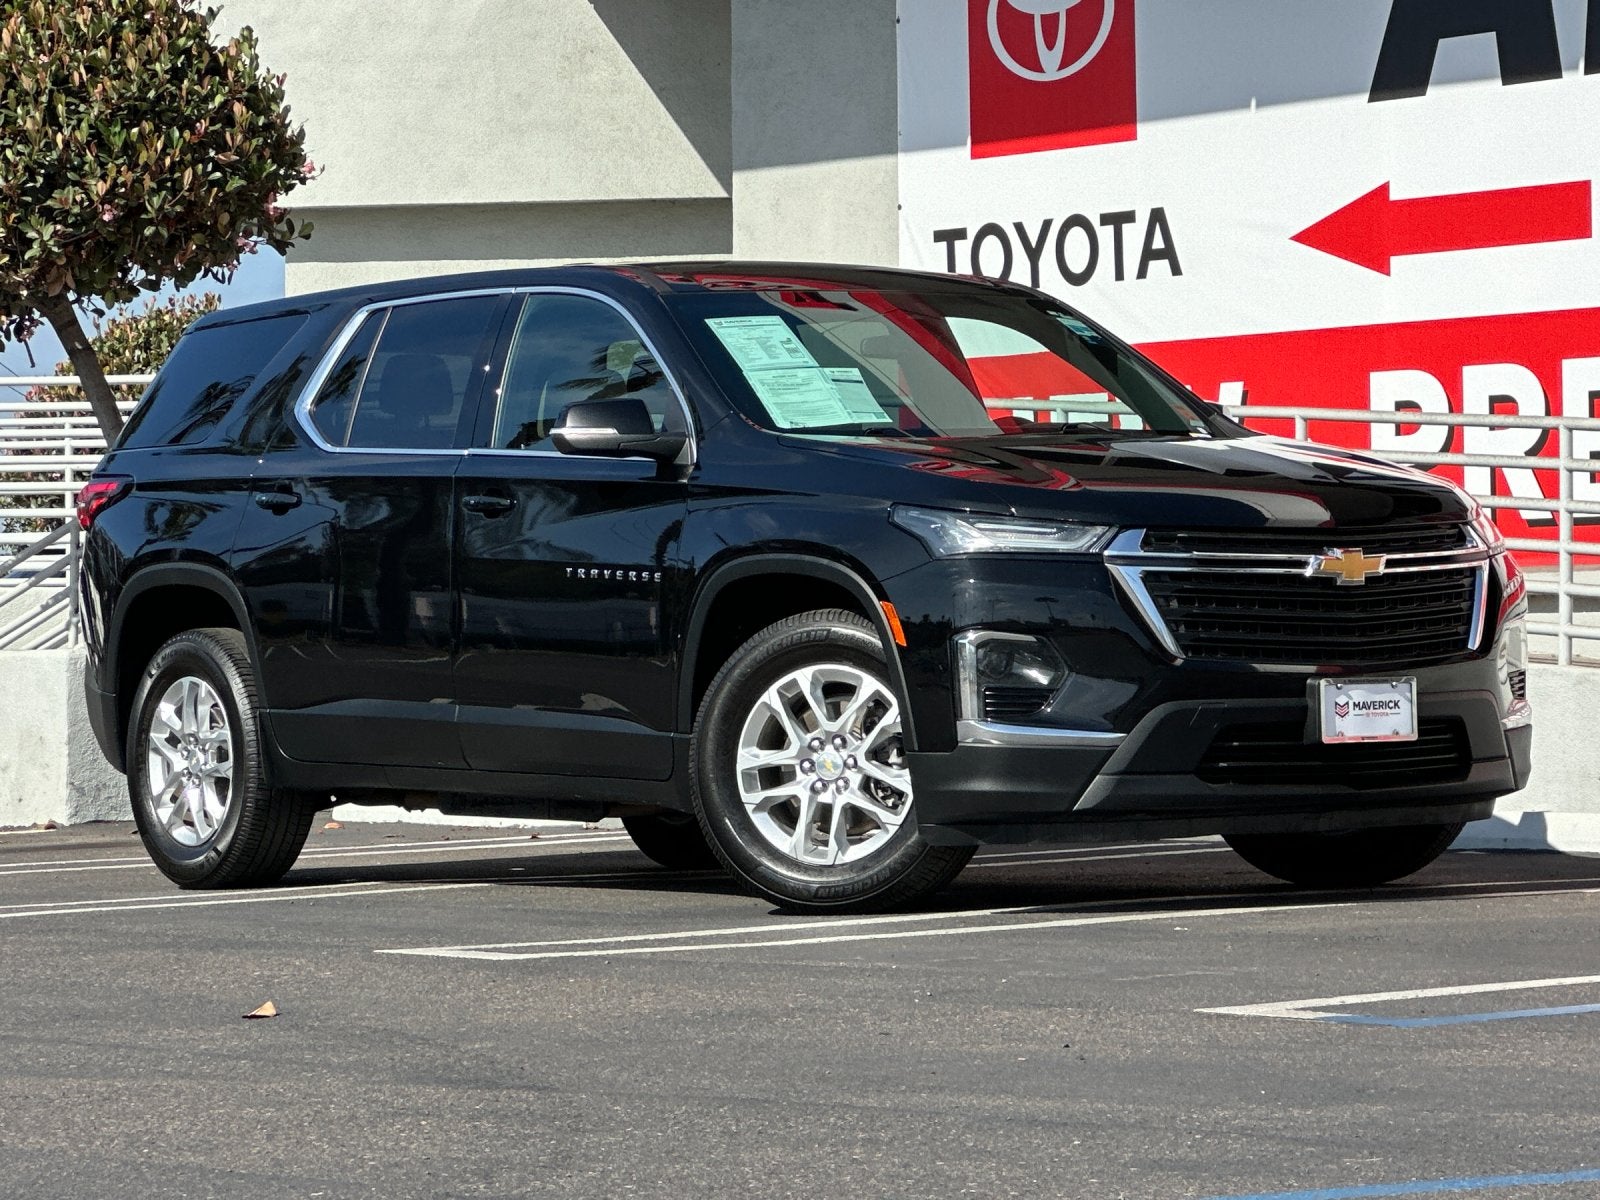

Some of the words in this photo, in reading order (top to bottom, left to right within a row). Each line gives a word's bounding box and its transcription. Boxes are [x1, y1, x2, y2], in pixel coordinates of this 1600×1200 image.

[934, 207, 1183, 288] TOYOTA
[565, 567, 662, 582] TRAVERSE
[1353, 699, 1401, 711] MAVERICK
